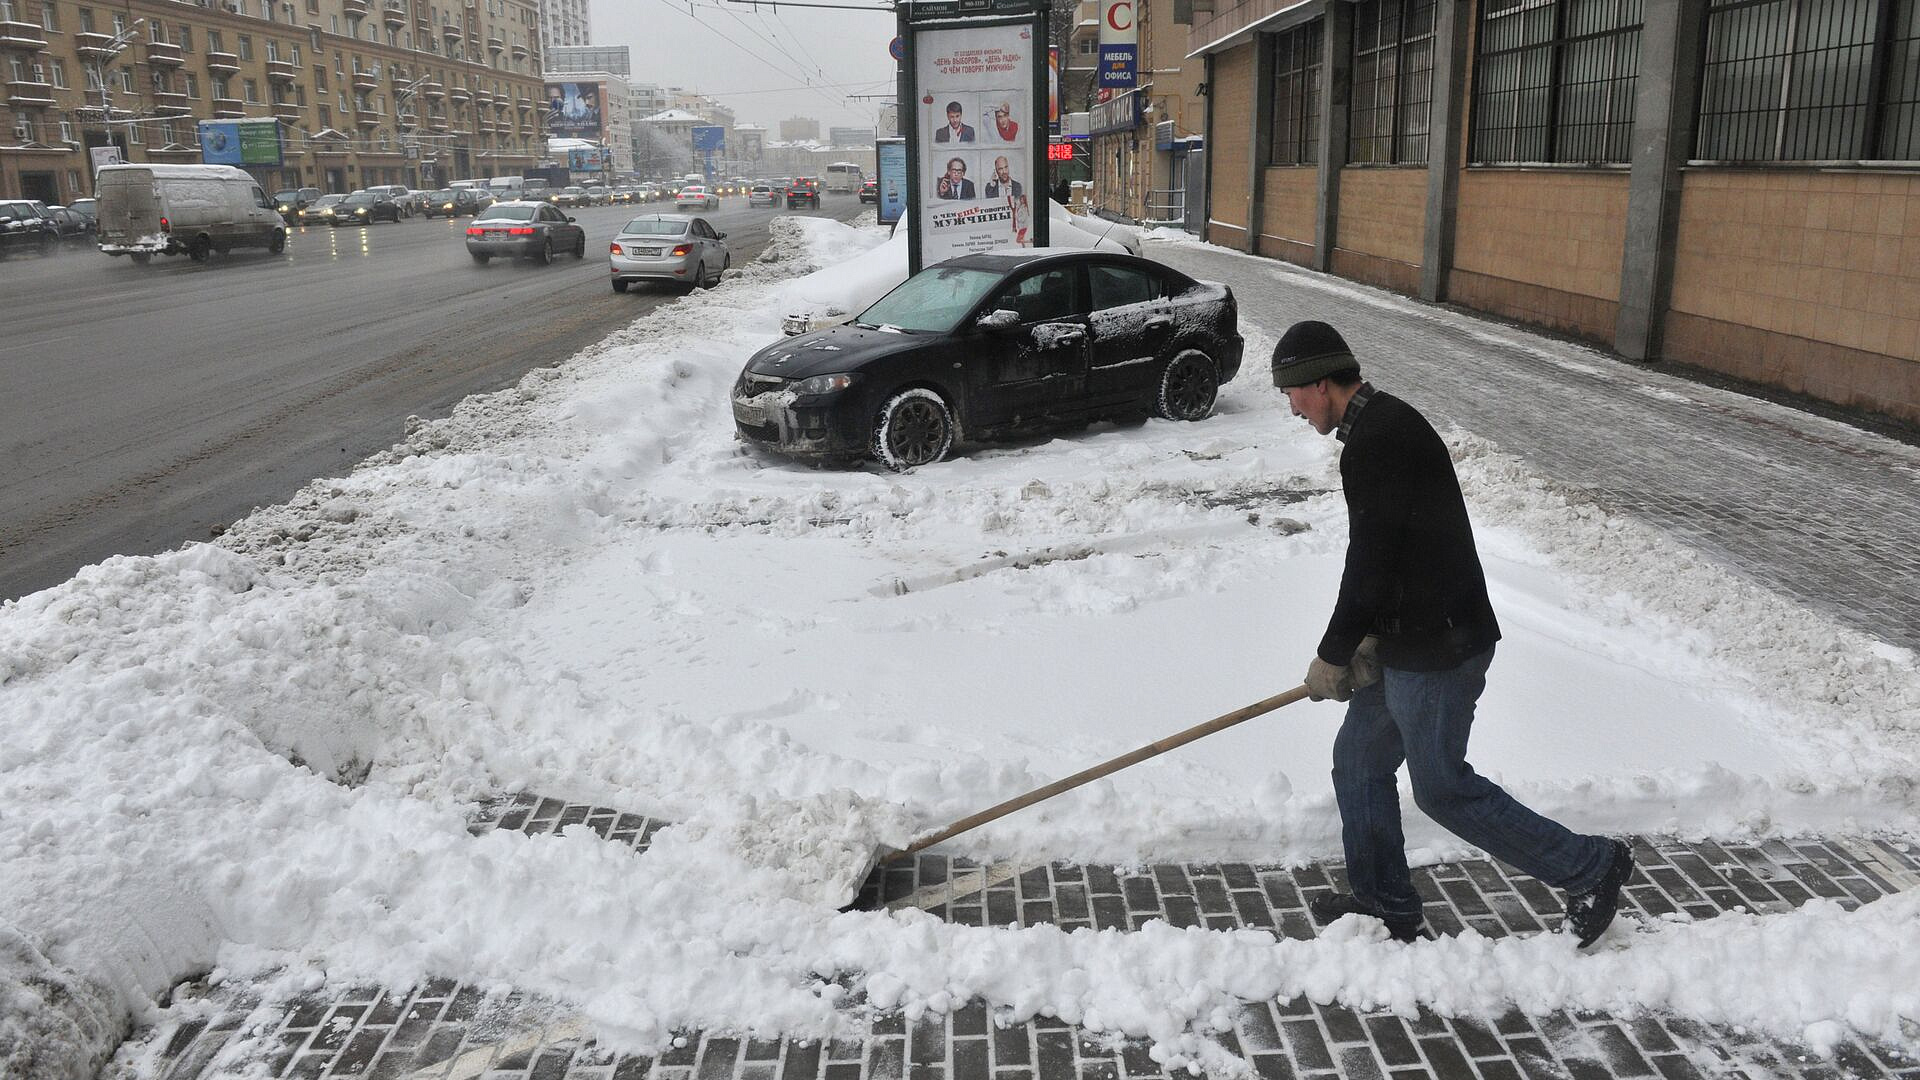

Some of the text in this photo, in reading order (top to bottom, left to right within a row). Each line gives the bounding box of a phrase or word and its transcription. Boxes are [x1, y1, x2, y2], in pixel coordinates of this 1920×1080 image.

[1107, 2, 1132, 31] С
[1104, 52, 1133, 61] МЕБЕЛЬ
[961, 65, 985, 73] ГОВОРЯТ
[1104, 71, 1132, 80] ОФИСА
[980, 205, 1011, 214] ГОВОРЯТ
[934, 211, 1012, 228] МУЖЧИНЫ
